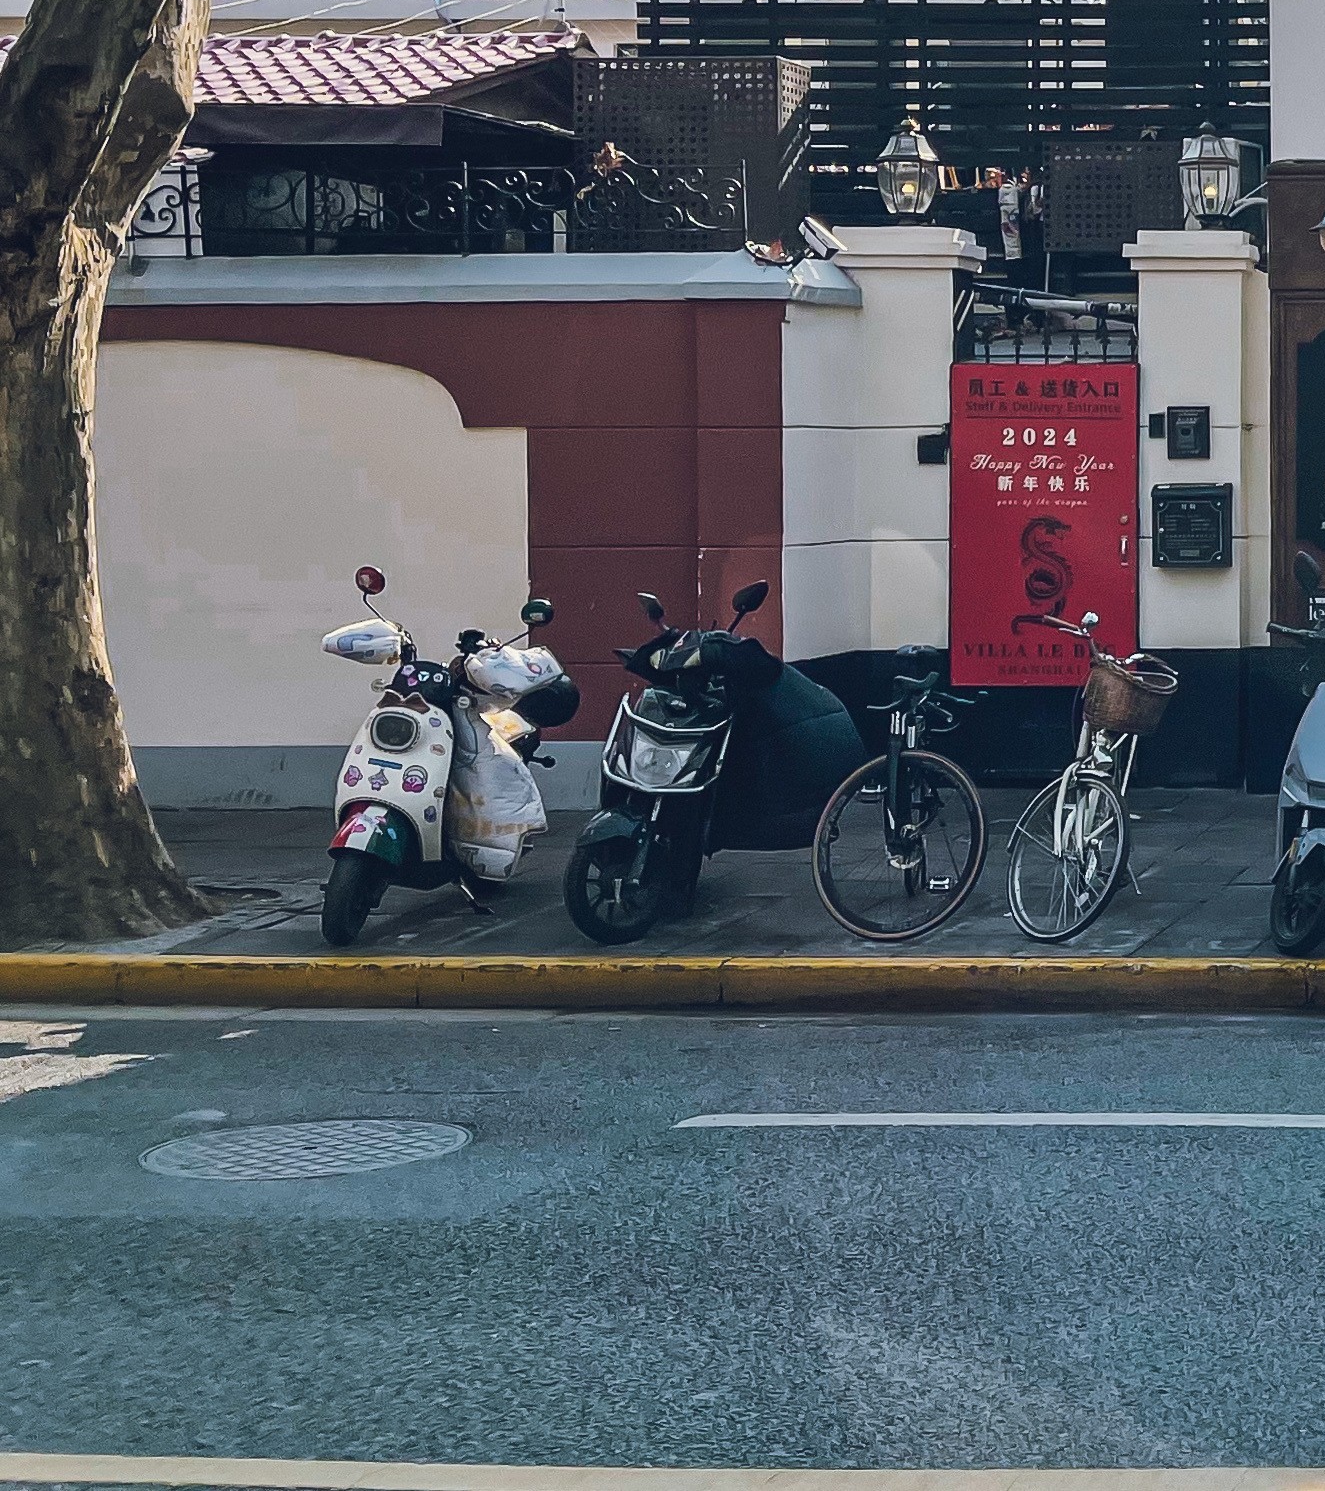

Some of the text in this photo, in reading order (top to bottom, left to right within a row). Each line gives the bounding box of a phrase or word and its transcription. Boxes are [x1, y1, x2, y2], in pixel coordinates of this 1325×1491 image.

[968, 378, 1006, 398] 员工
[1015, 380, 1030, 397] &
[1002, 427, 1077, 446] 2024
[970, 453, 1115, 475] Happy New Year
[997, 475, 1090, 492] 新年快乐
[1308, 605, 1325, 621] le
[963, 642, 1028, 658] VILLA
[1073, 642, 1116, 658] BC
